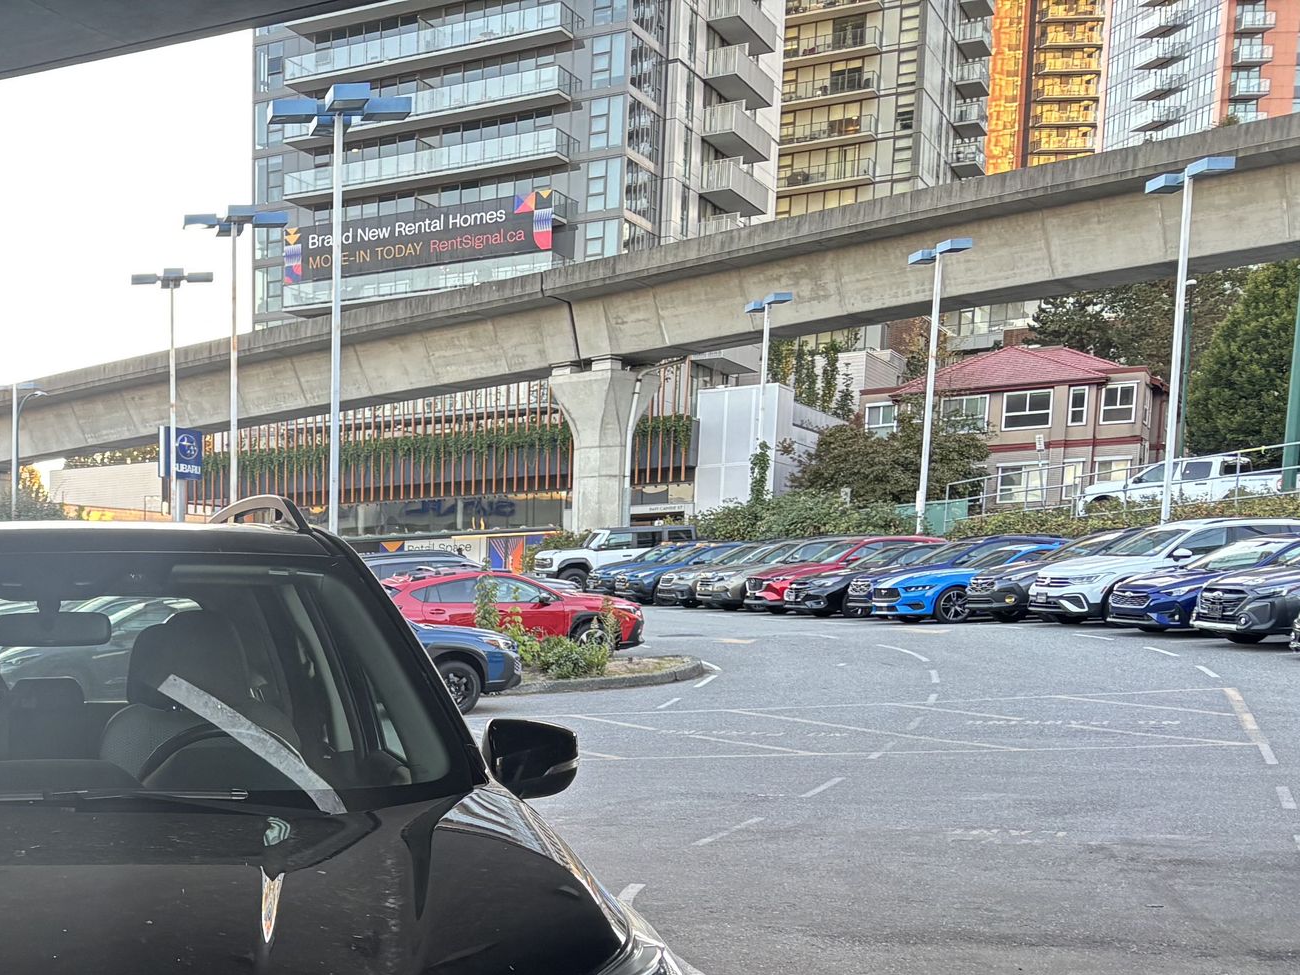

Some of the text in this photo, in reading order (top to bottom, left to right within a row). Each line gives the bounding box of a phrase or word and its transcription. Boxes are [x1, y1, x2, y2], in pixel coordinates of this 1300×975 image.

[308, 209, 506, 249] Brad New Rental Homes
[308, 248, 370, 269] MOE-IN
[375, 241, 423, 260] TODAY
[174, 463, 201, 474] UBARU
